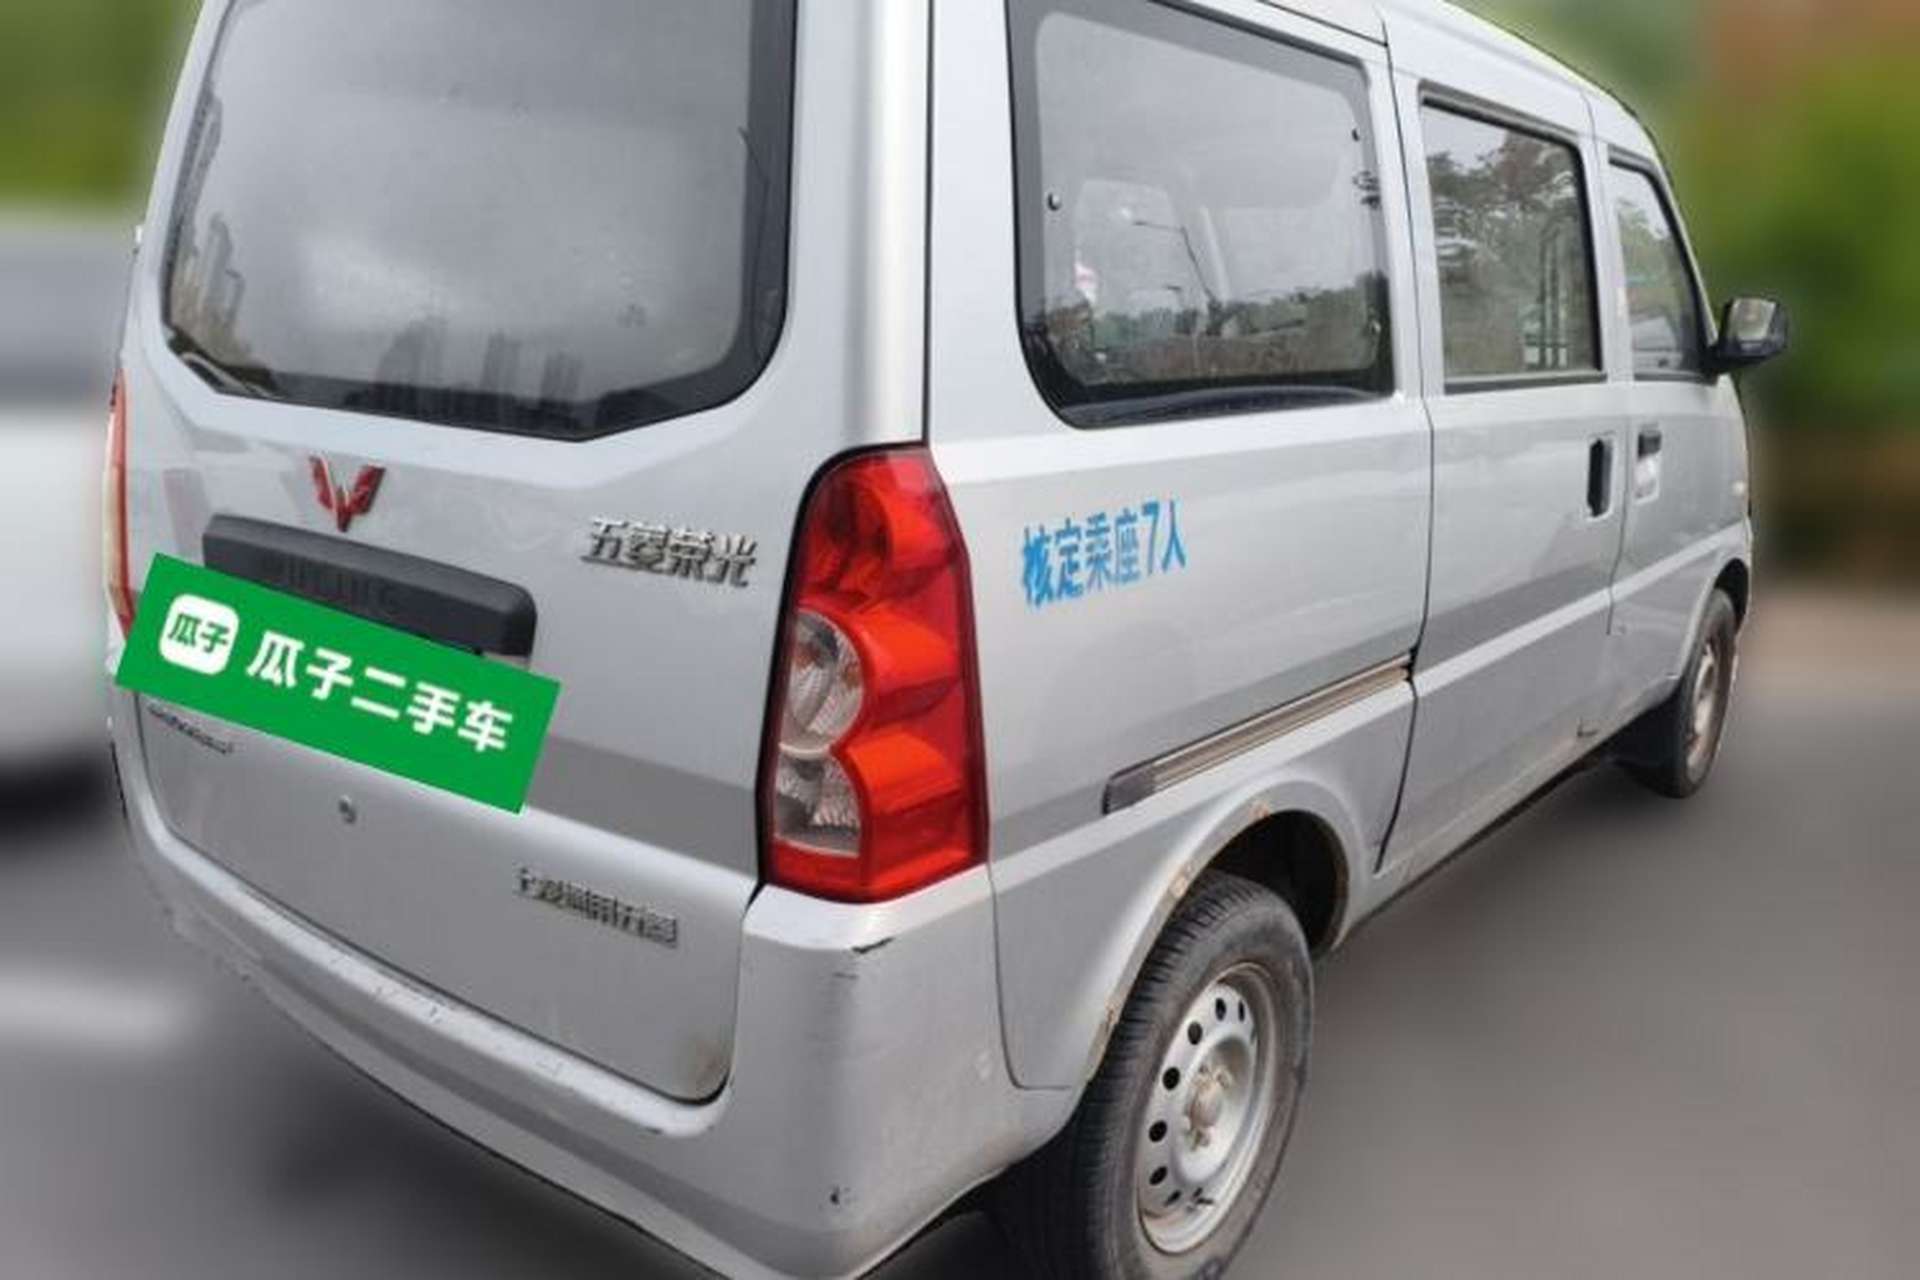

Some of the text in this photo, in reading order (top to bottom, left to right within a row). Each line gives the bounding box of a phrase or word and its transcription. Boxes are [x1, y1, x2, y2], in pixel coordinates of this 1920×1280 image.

[580, 515, 757, 587] 五菱荣光
[1023, 500, 1186, 606] 核定乘座7人
